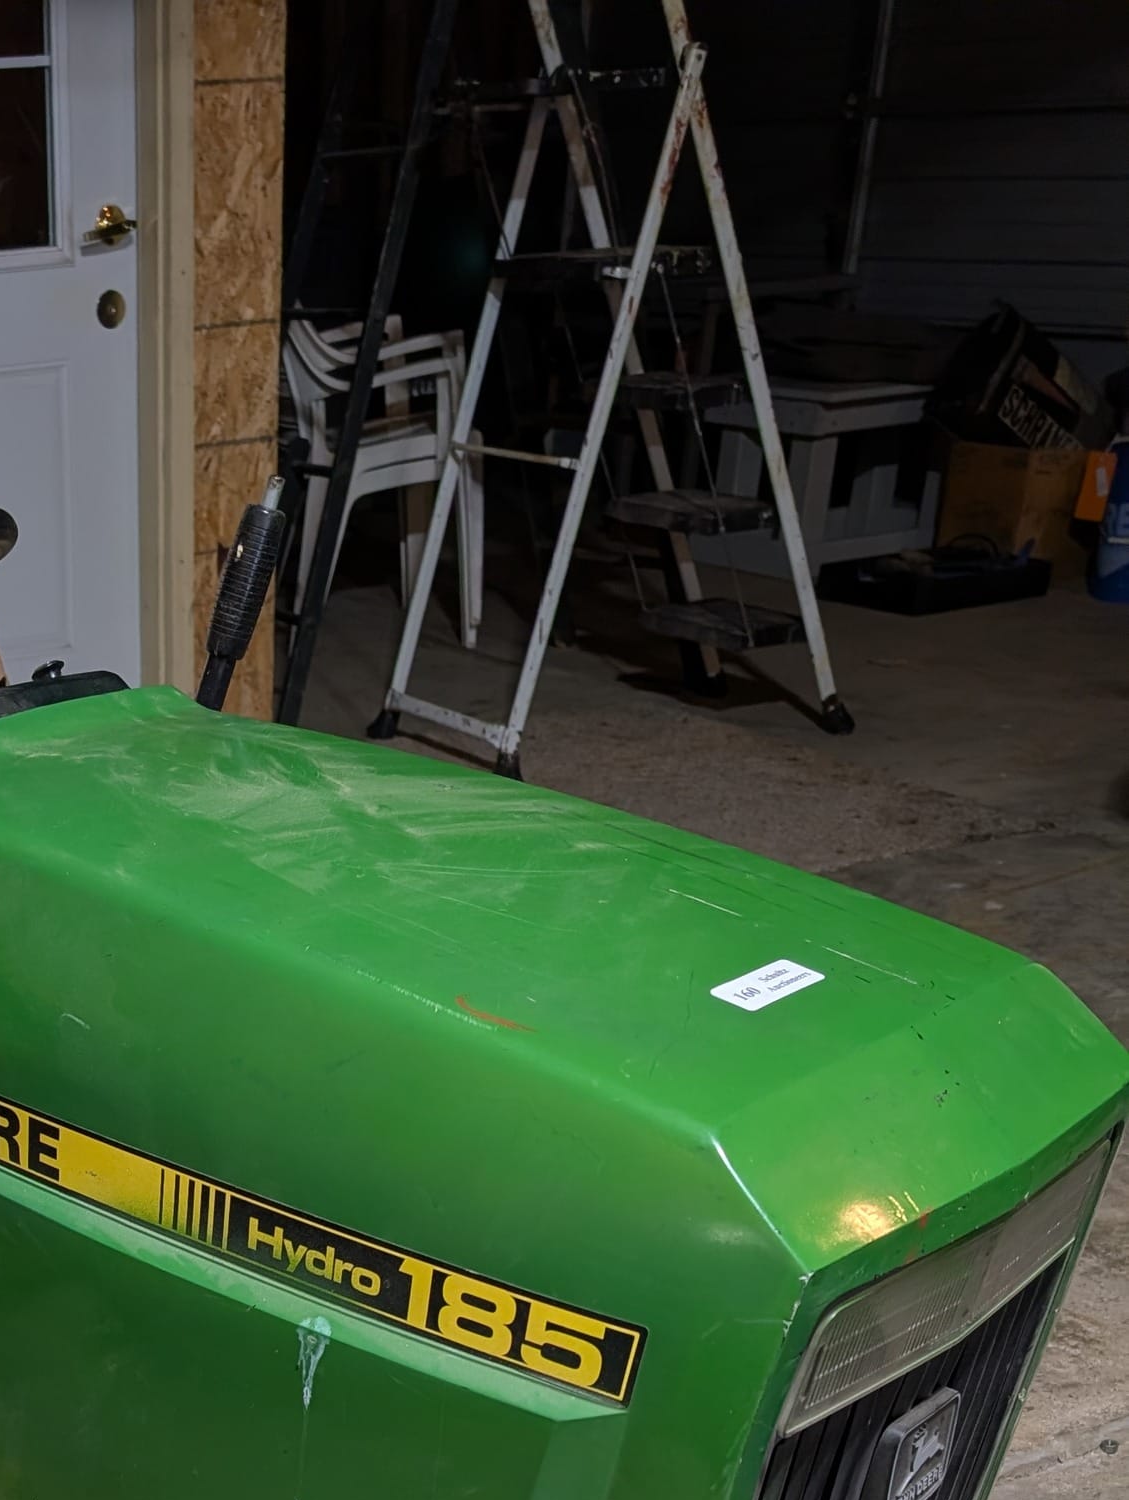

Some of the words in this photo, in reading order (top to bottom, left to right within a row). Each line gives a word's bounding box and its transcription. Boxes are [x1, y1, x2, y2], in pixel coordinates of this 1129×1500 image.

[733, 986, 762, 1001] 160
[247, 1217, 381, 1296] Hydro
[399, 1257, 606, 1387] 185
[916, 1463, 944, 1496] DEERE
